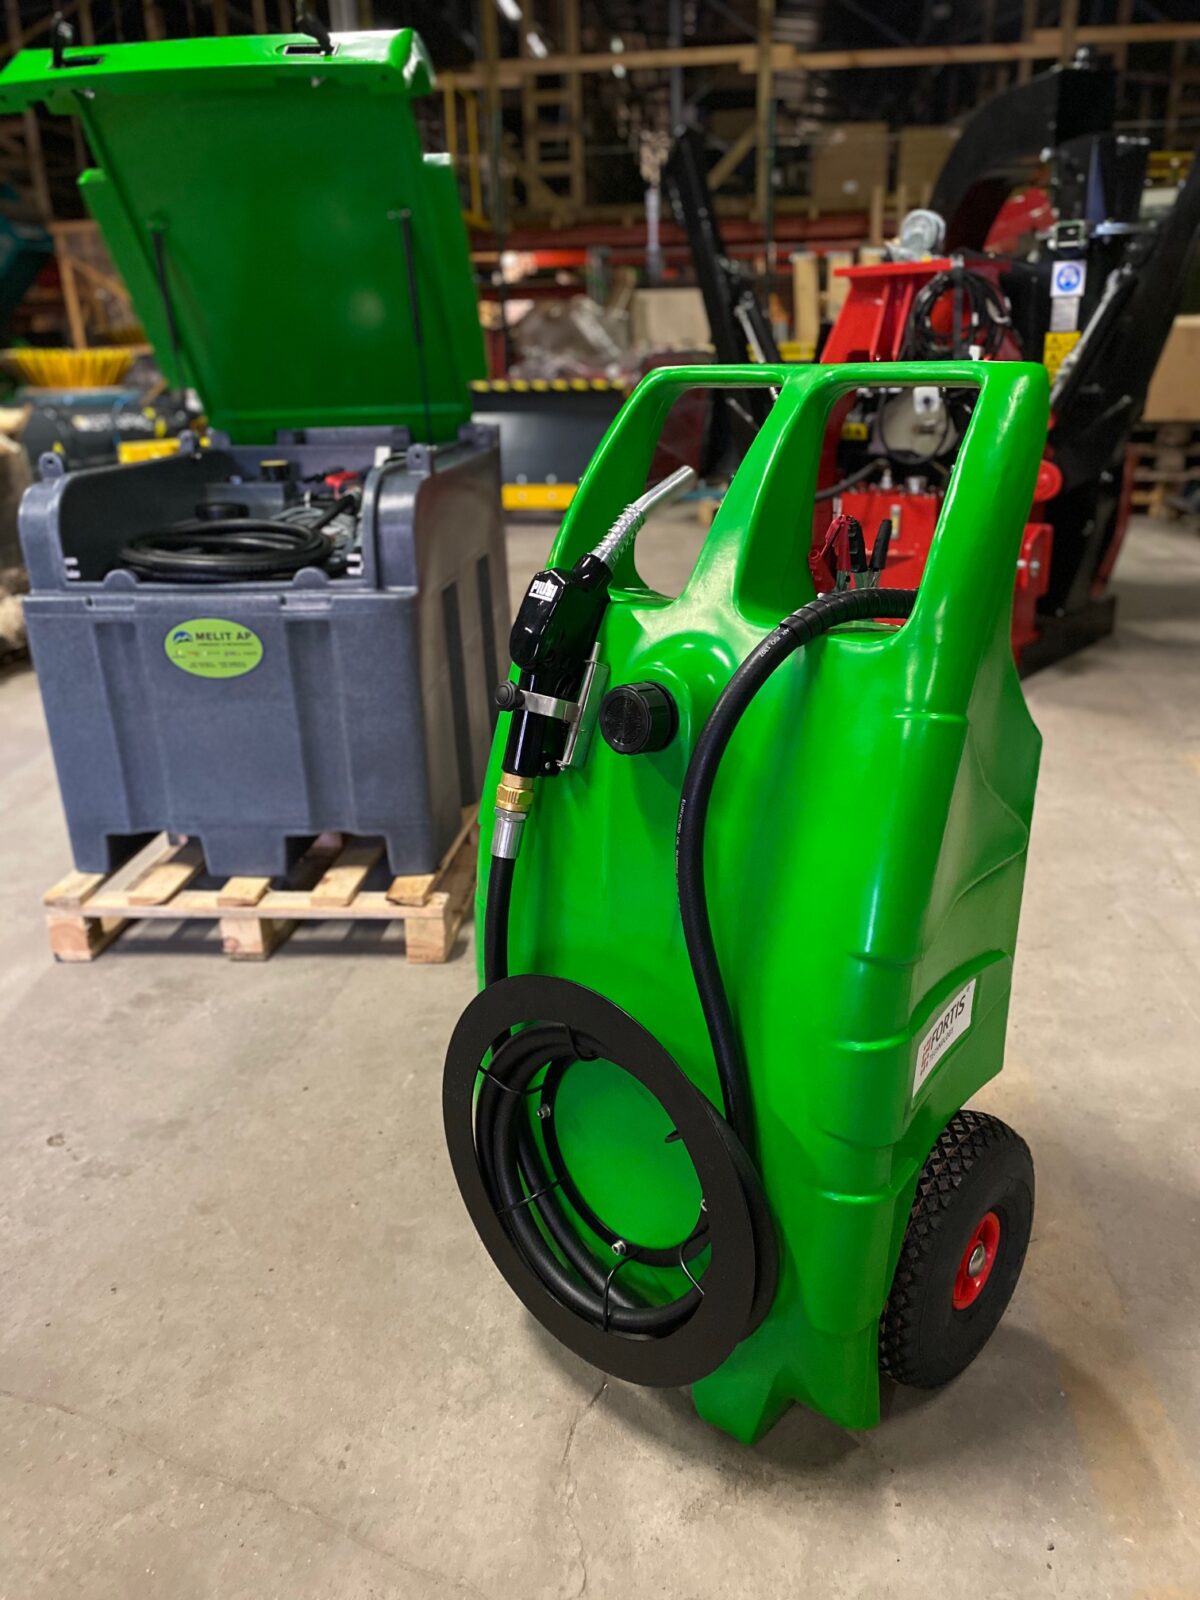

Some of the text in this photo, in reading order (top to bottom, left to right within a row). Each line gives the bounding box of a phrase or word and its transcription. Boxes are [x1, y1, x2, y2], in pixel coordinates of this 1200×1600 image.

[530, 579, 558, 600] PIUSI
[195, 631, 231, 641] MELIT
[931, 994, 966, 1050] FORTIS
